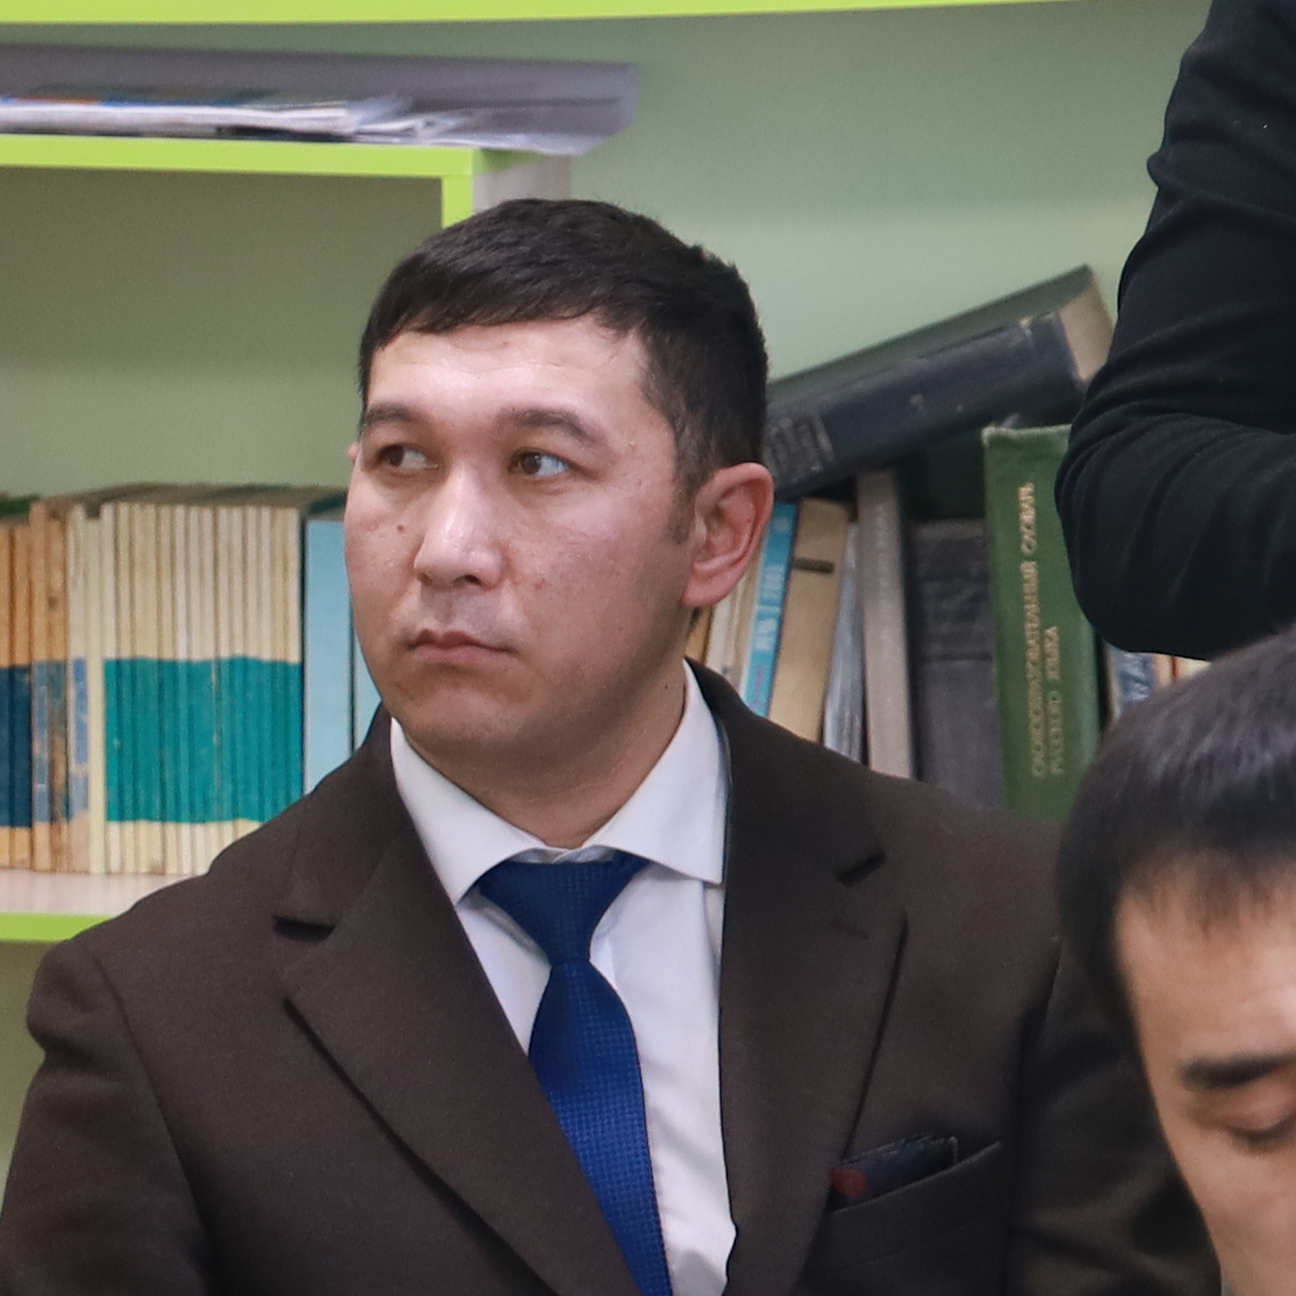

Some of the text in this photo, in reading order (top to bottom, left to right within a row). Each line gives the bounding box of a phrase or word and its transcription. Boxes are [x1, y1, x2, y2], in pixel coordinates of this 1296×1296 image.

[1018, 482, 1037, 554] СЛОВАРЬ
[1044, 626, 1064, 776] РУССКОГО ЯЗЫКА
